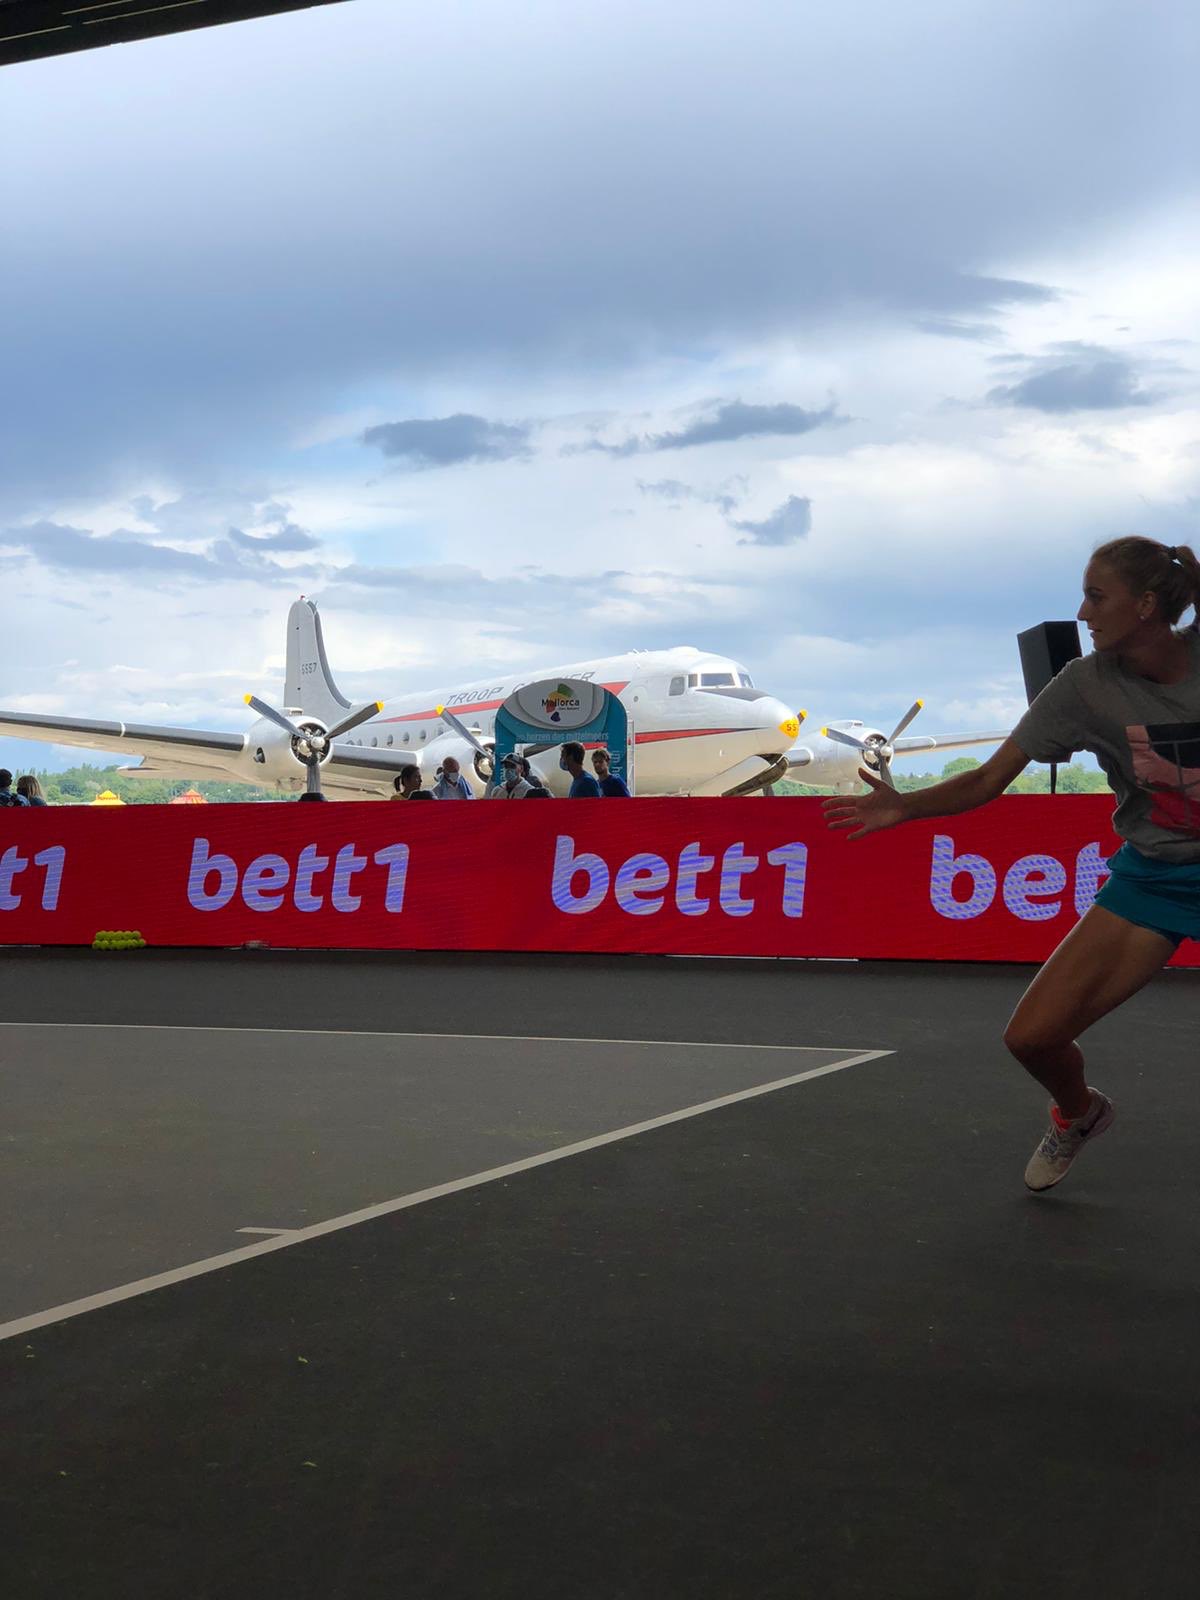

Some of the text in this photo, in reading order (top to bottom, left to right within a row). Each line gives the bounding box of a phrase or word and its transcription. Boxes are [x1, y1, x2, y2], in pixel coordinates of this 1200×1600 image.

[446, 686, 505, 706] TROOP
[188, 838, 409, 912] bett1
[551, 836, 807, 918] bett1
